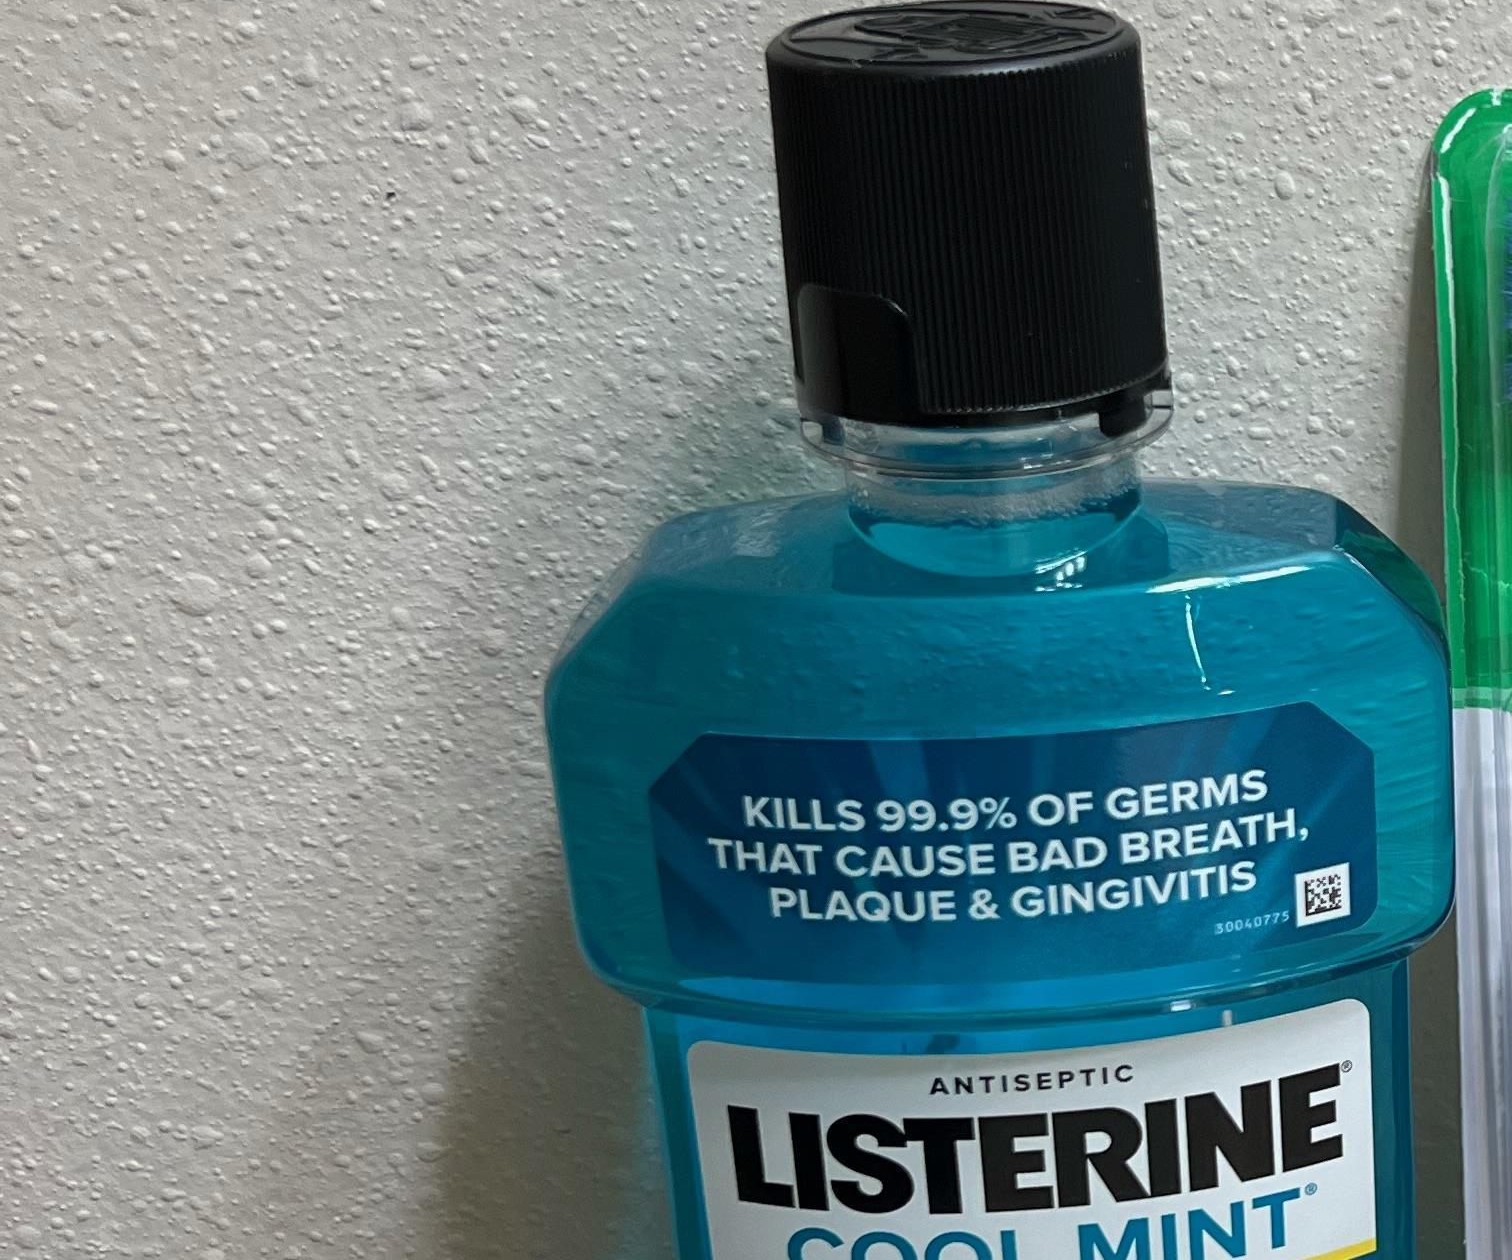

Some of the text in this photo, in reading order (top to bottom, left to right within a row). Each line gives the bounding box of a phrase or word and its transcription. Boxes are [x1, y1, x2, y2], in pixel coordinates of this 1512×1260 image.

[743, 769, 1268, 833] KILLS 99.9% OF GERMS
[707, 808, 1309, 879] THAT CAUSE BAD BREATH,
[771, 860, 1257, 923] PLAQUE & GINGIVITIS
[1214, 910, 1290, 935] 30040775
[929, 1064, 1136, 1096] ANTISEPTIC
